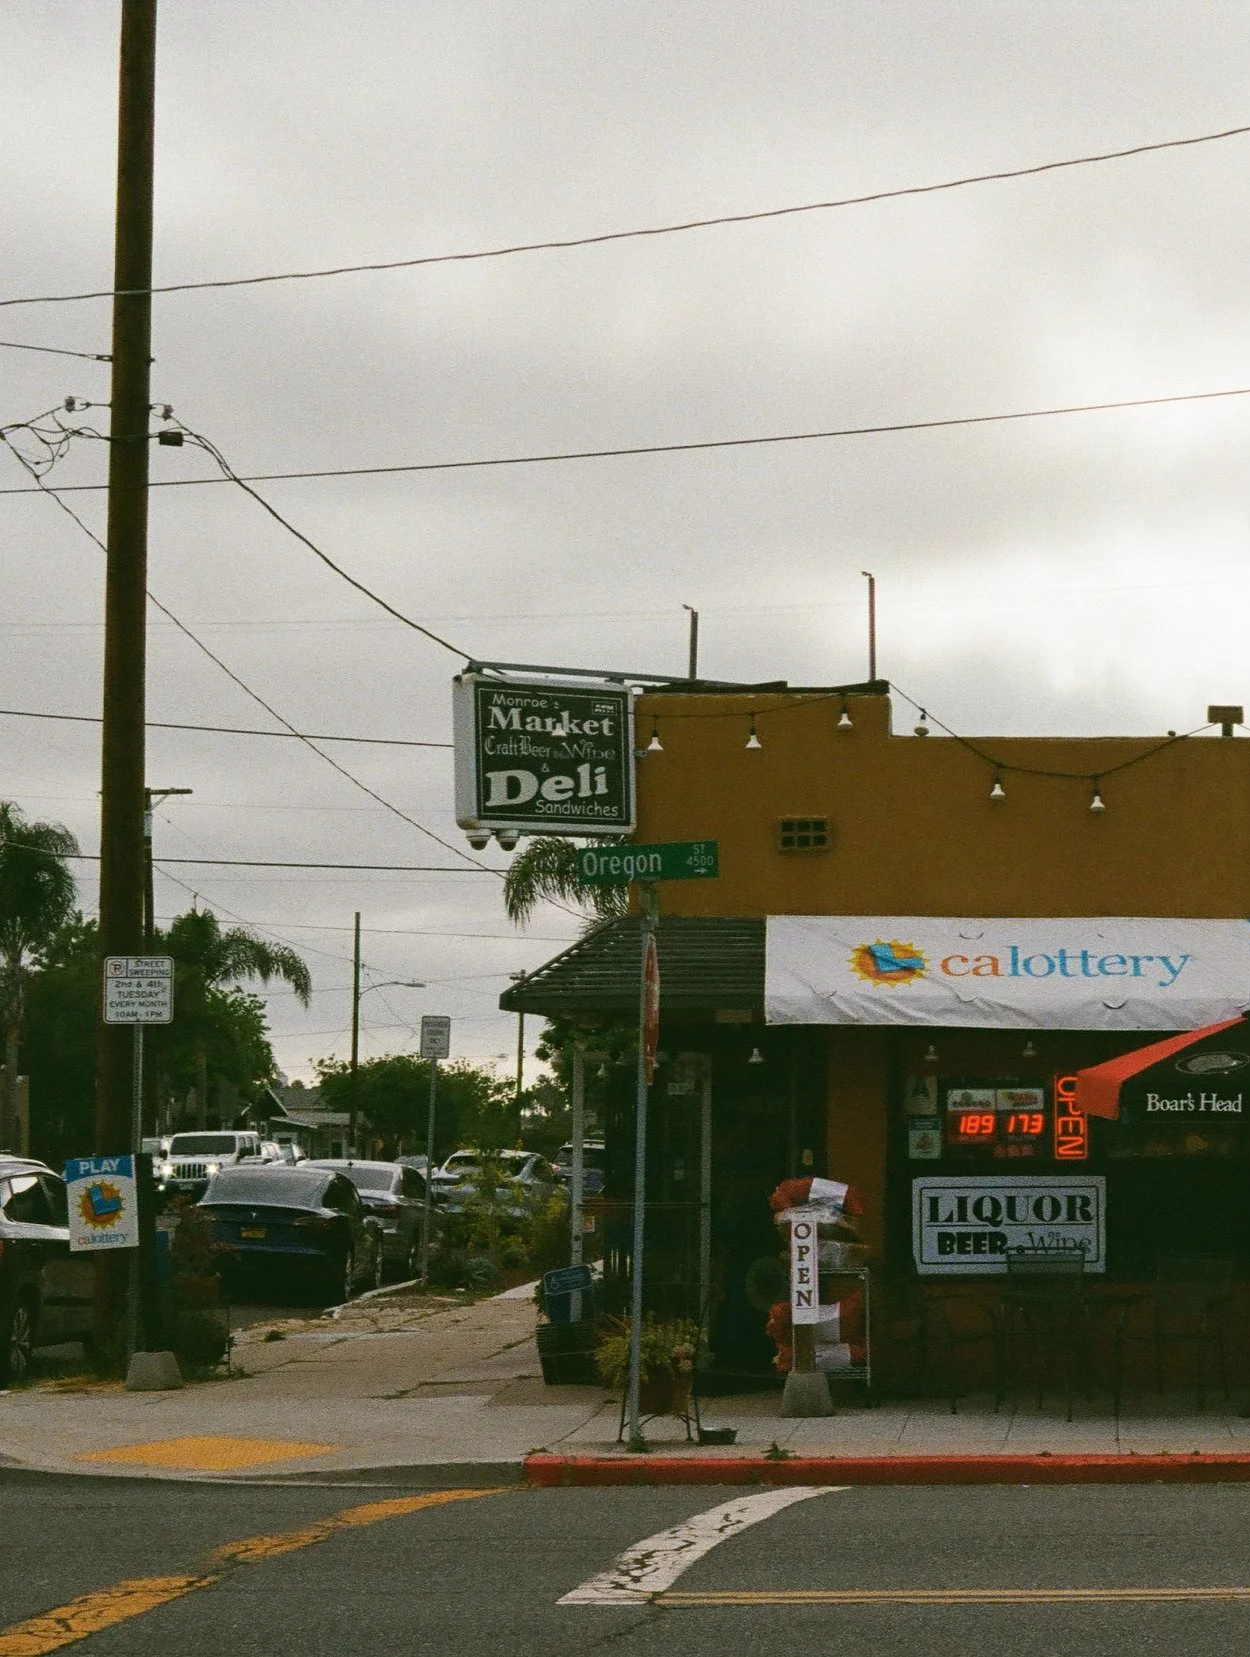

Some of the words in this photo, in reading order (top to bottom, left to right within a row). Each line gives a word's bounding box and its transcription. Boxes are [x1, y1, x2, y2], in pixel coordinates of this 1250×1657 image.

[487, 706, 615, 737] Market
[484, 735, 518, 756] Craft
[519, 735, 551, 757] Beer
[561, 738, 616, 760] Wine
[541, 763, 550, 773] &
[485, 762, 609, 807] Deli
[535, 799, 619, 817] Sandwiches
[693, 843, 705, 855] ST
[582, 851, 662, 882] Oregon
[686, 855, 714, 867] 4500
[129, 968, 170, 976] SWEEPING
[134, 960, 165, 968] STREET
[940, 945, 1192, 987] calottery
[114, 980, 132, 988] 2nd
[117, 990, 159, 999] TUESDAY
[1146, 1093, 1195, 1112] Boar's
[1199, 1093, 1243, 1113] Head
[959, 1113, 996, 1134] 189
[1008, 1113, 1044, 1134] 173
[80, 1159, 120, 1175] PLAY
[926, 1194, 1095, 1228] LIQUOR
[78, 1232, 128, 1245] calottery
[937, 1231, 1009, 1256] BEER
[1028, 1231, 1092, 1253] Wine
[794, 1222, 813, 1308] OPEN
